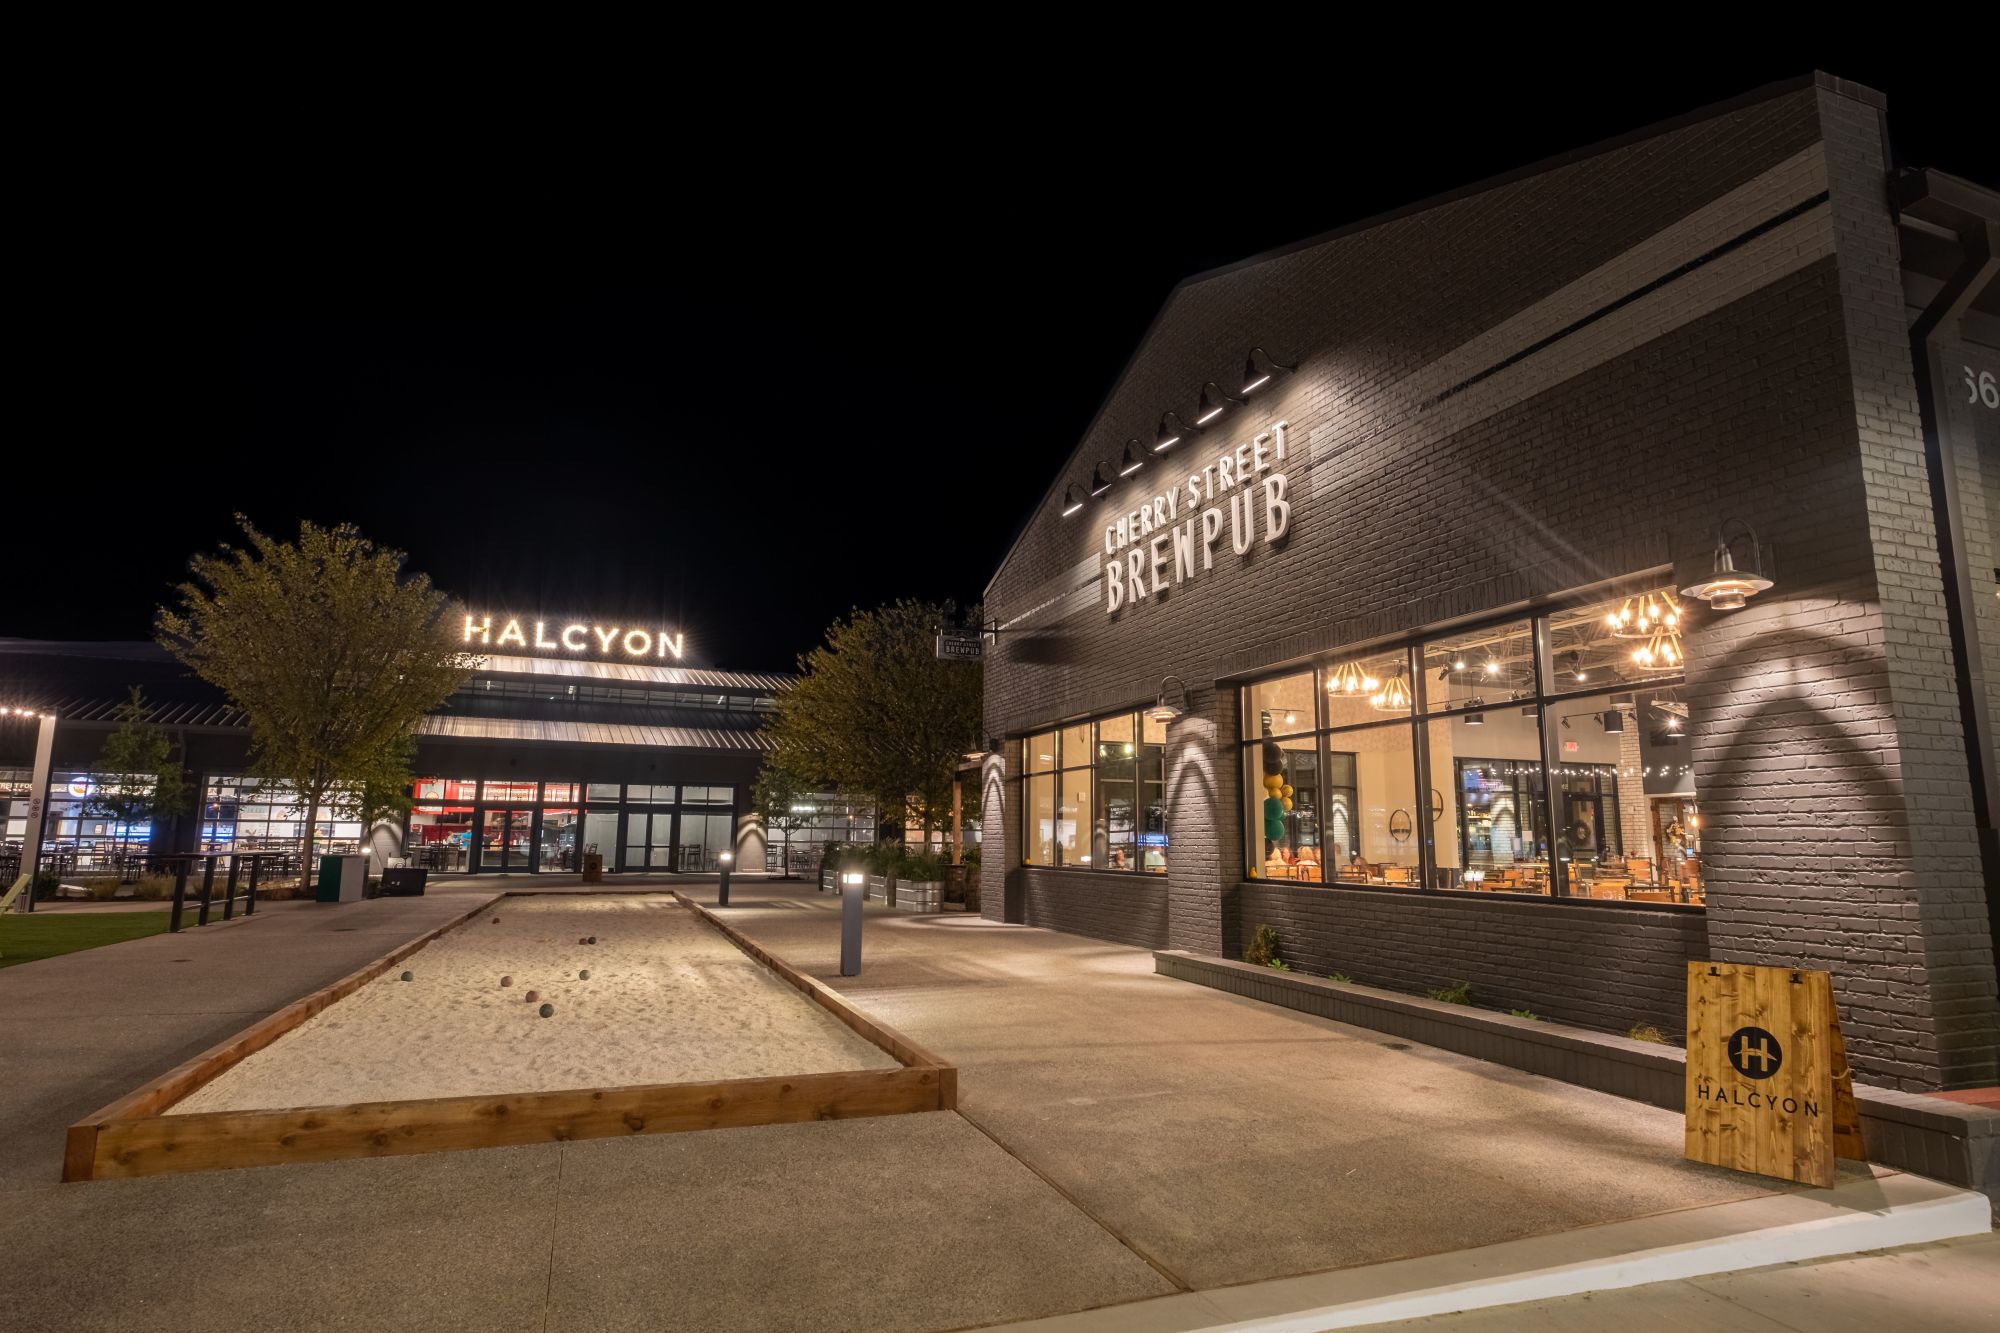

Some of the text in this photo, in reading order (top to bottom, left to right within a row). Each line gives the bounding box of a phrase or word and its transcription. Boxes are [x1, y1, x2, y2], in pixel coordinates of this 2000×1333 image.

[1105, 420, 1289, 555] CHERRY STREET
[1106, 473, 1291, 614] BREWPUB
[463, 615, 684, 658] HALCYON
[945, 646, 980, 655] BREWPUB
[1698, 1084, 1819, 1118] HALCYON
